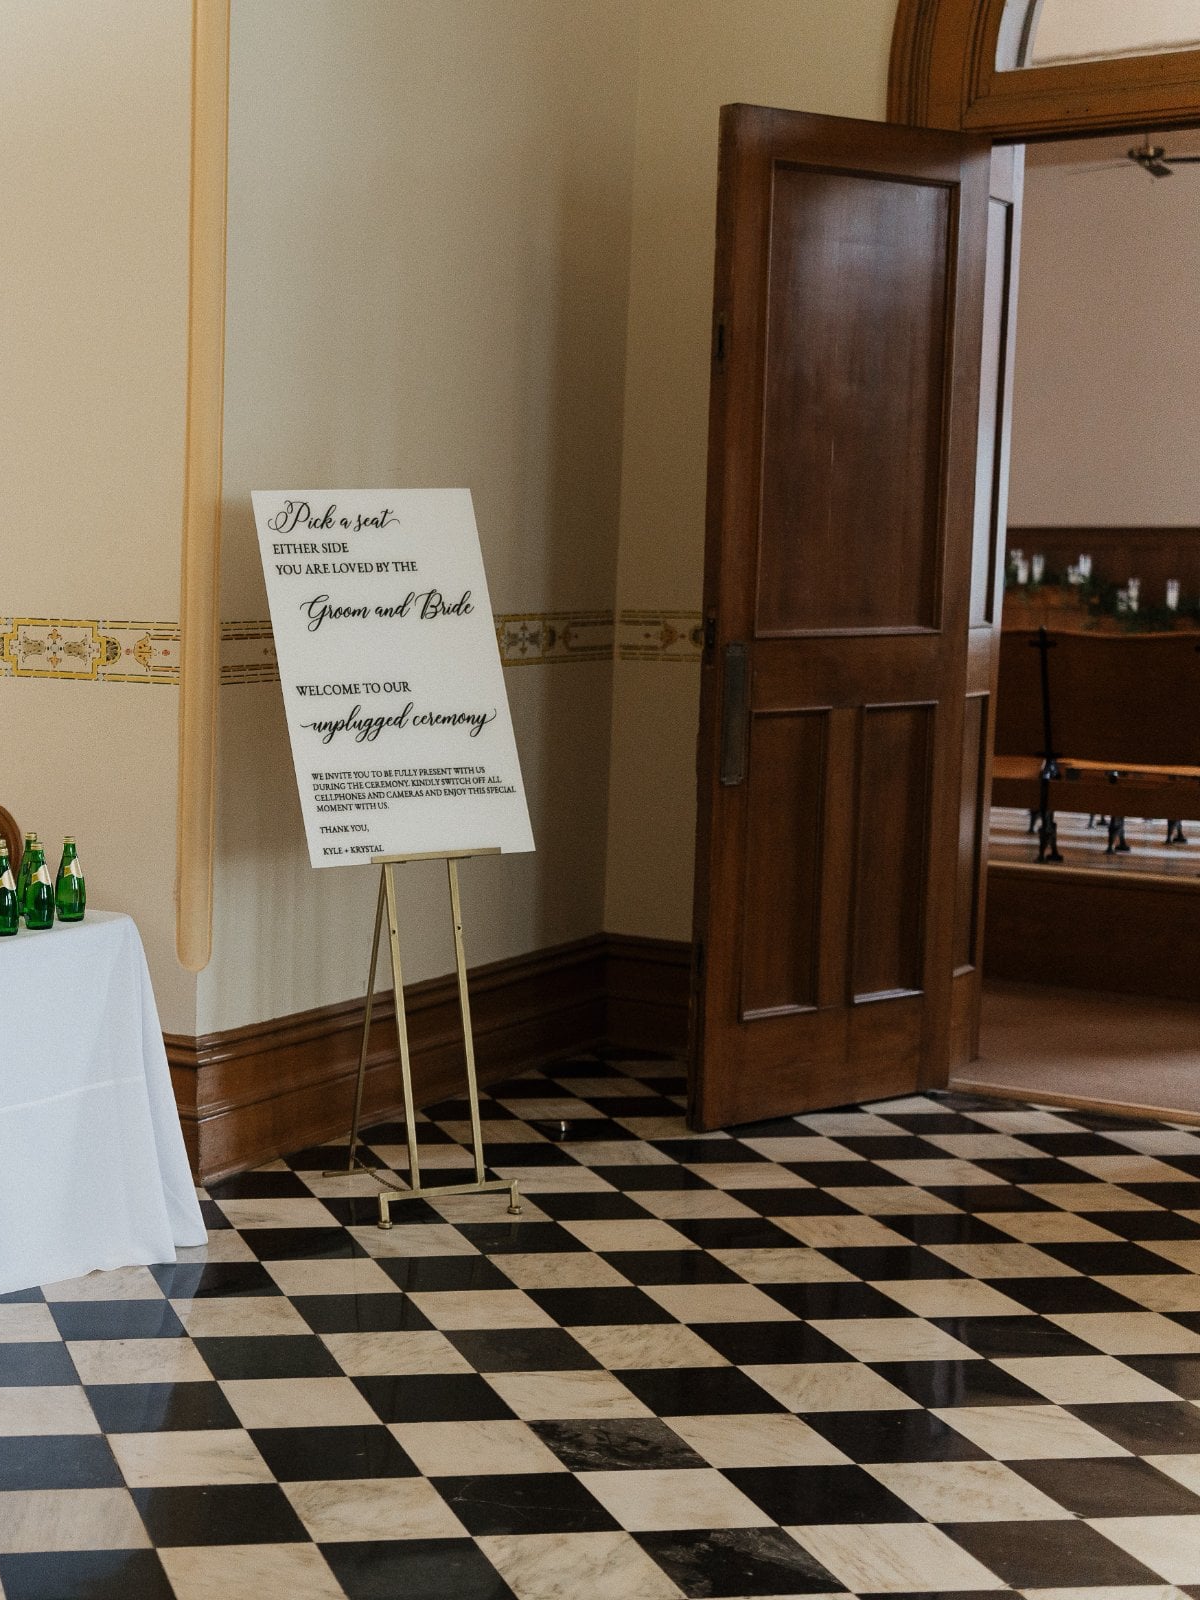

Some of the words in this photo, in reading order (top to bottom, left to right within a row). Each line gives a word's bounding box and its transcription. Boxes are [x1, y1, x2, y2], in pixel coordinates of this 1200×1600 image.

[268, 500, 337, 533] Pick
[340, 517, 351, 529] a
[353, 509, 400, 532] seat
[273, 543, 319, 554] EITHER
[322, 542, 349, 553] SIDE
[276, 564, 302, 575] YOU
[305, 563, 330, 574] ARE
[332, 563, 373, 573] LOVED
[377, 562, 390, 572] BY
[392, 561, 417, 572] THE
[300, 594, 370, 632] Groom
[375, 591, 415, 618] and
[415, 589, 474, 619] Bride
[296, 685, 361, 696] WELCOME
[362, 683, 380, 693] TO
[383, 681, 411, 692] OUR
[300, 701, 414, 744] unplugged
[412, 708, 497, 737] ceremony
[325, 772, 351, 780] INVITE
[371, 770, 383, 778] TO
[384, 769, 393, 777] BE
[394, 769, 418, 777] FULLY
[419, 768, 452, 776] PRESENT
[453, 766, 475, 774] WITH
[475, 766, 486, 774] US
[313, 783, 346, 791] DURING
[347, 782, 364, 790] THE
[365, 780, 410, 789] CEREMONY.
[411, 779, 441, 787] KINDLY
[441, 777, 471, 786] SWITCH
[487, 776, 502, 784] ALL
[315, 793, 366, 801] CELLPHONES
[367, 792, 385, 800] AND
[386, 790, 424, 799] CAMERAS
[425, 789, 443, 797] AND
[444, 787, 467, 797] ENJOY
[468, 787, 486, 795] THIS
[486, 786, 516, 794] SPECIAL
[316, 804, 353, 812] MOMENT
[320, 826, 350, 834] THANK
[350, 824, 370, 832] YOU,
[323, 847, 343, 855] KYLE
[350, 845, 385, 854] KRYSTAL
